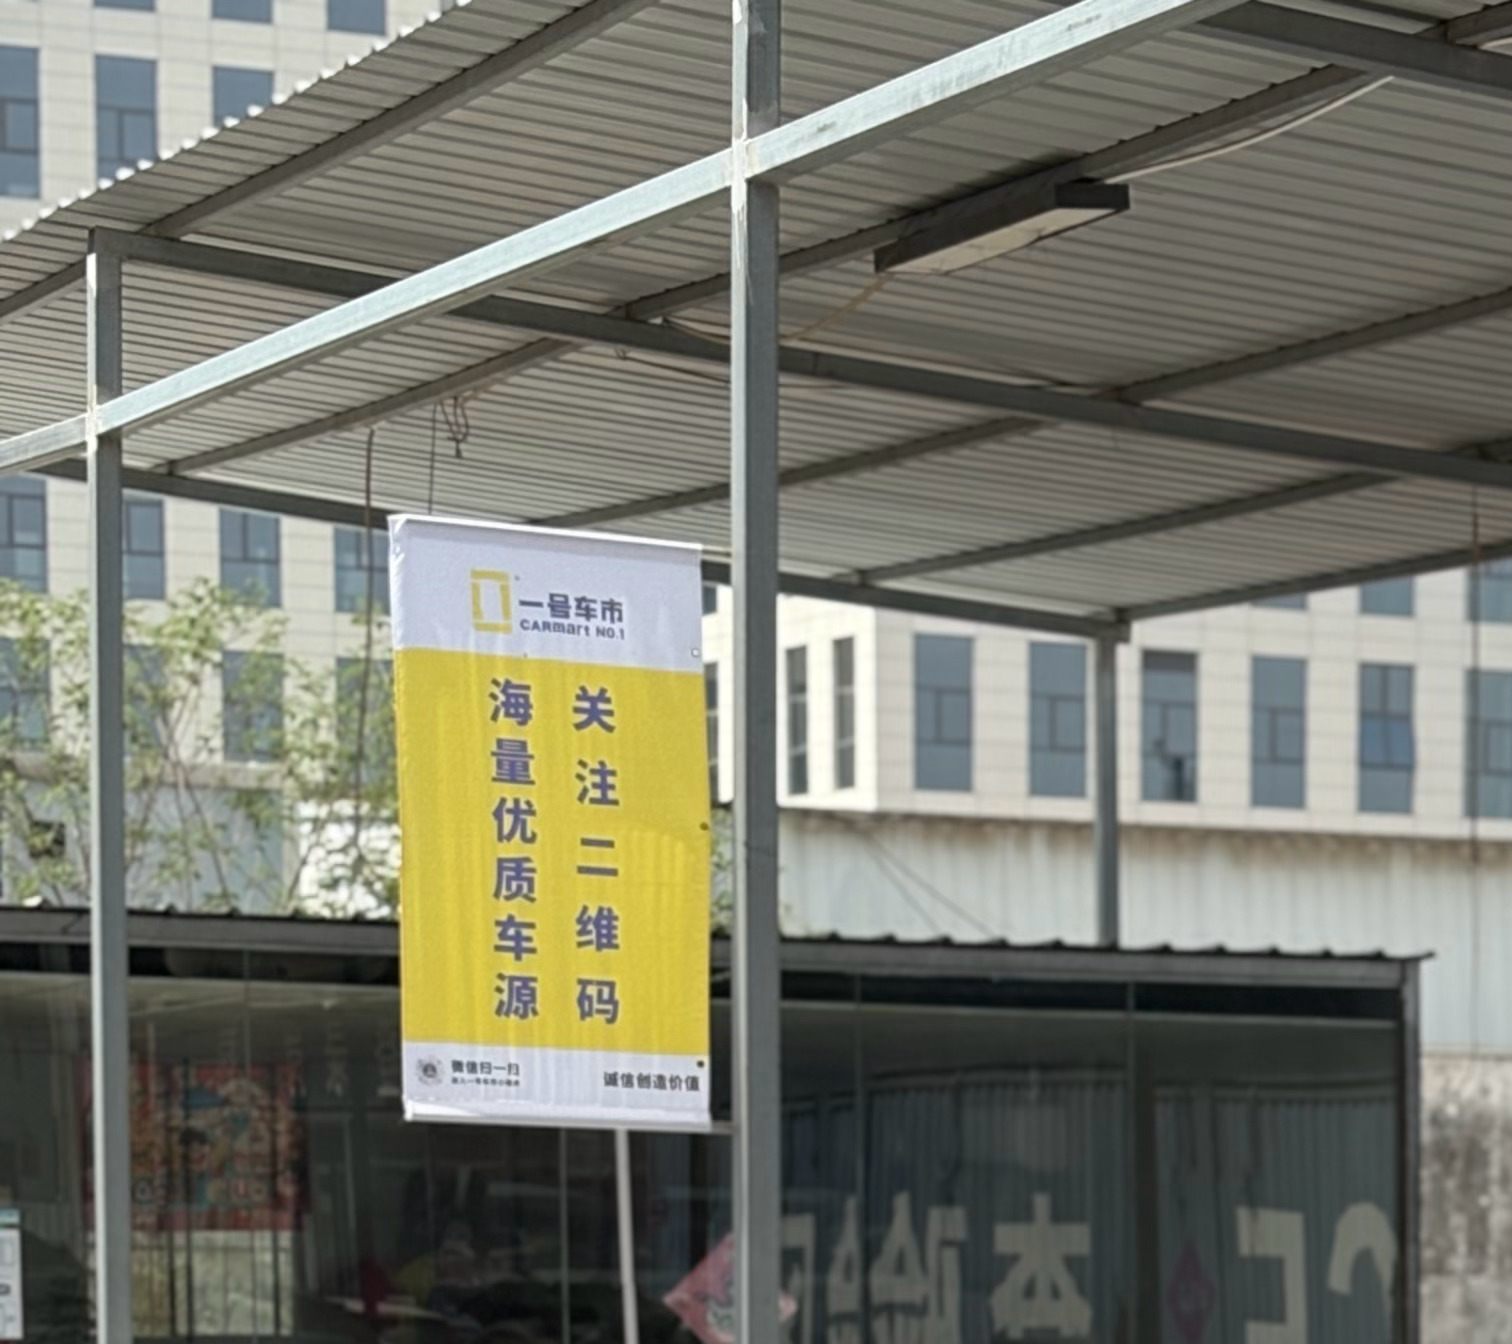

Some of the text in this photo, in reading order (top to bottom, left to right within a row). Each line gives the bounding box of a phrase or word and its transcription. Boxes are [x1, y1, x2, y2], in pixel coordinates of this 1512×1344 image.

[518, 592, 624, 625] 一号车市
[489, 677, 541, 1021] 海量优质车源
[572, 685, 621, 1026] 关注二维码
[603, 1070, 700, 1092] 诚信创造价值
